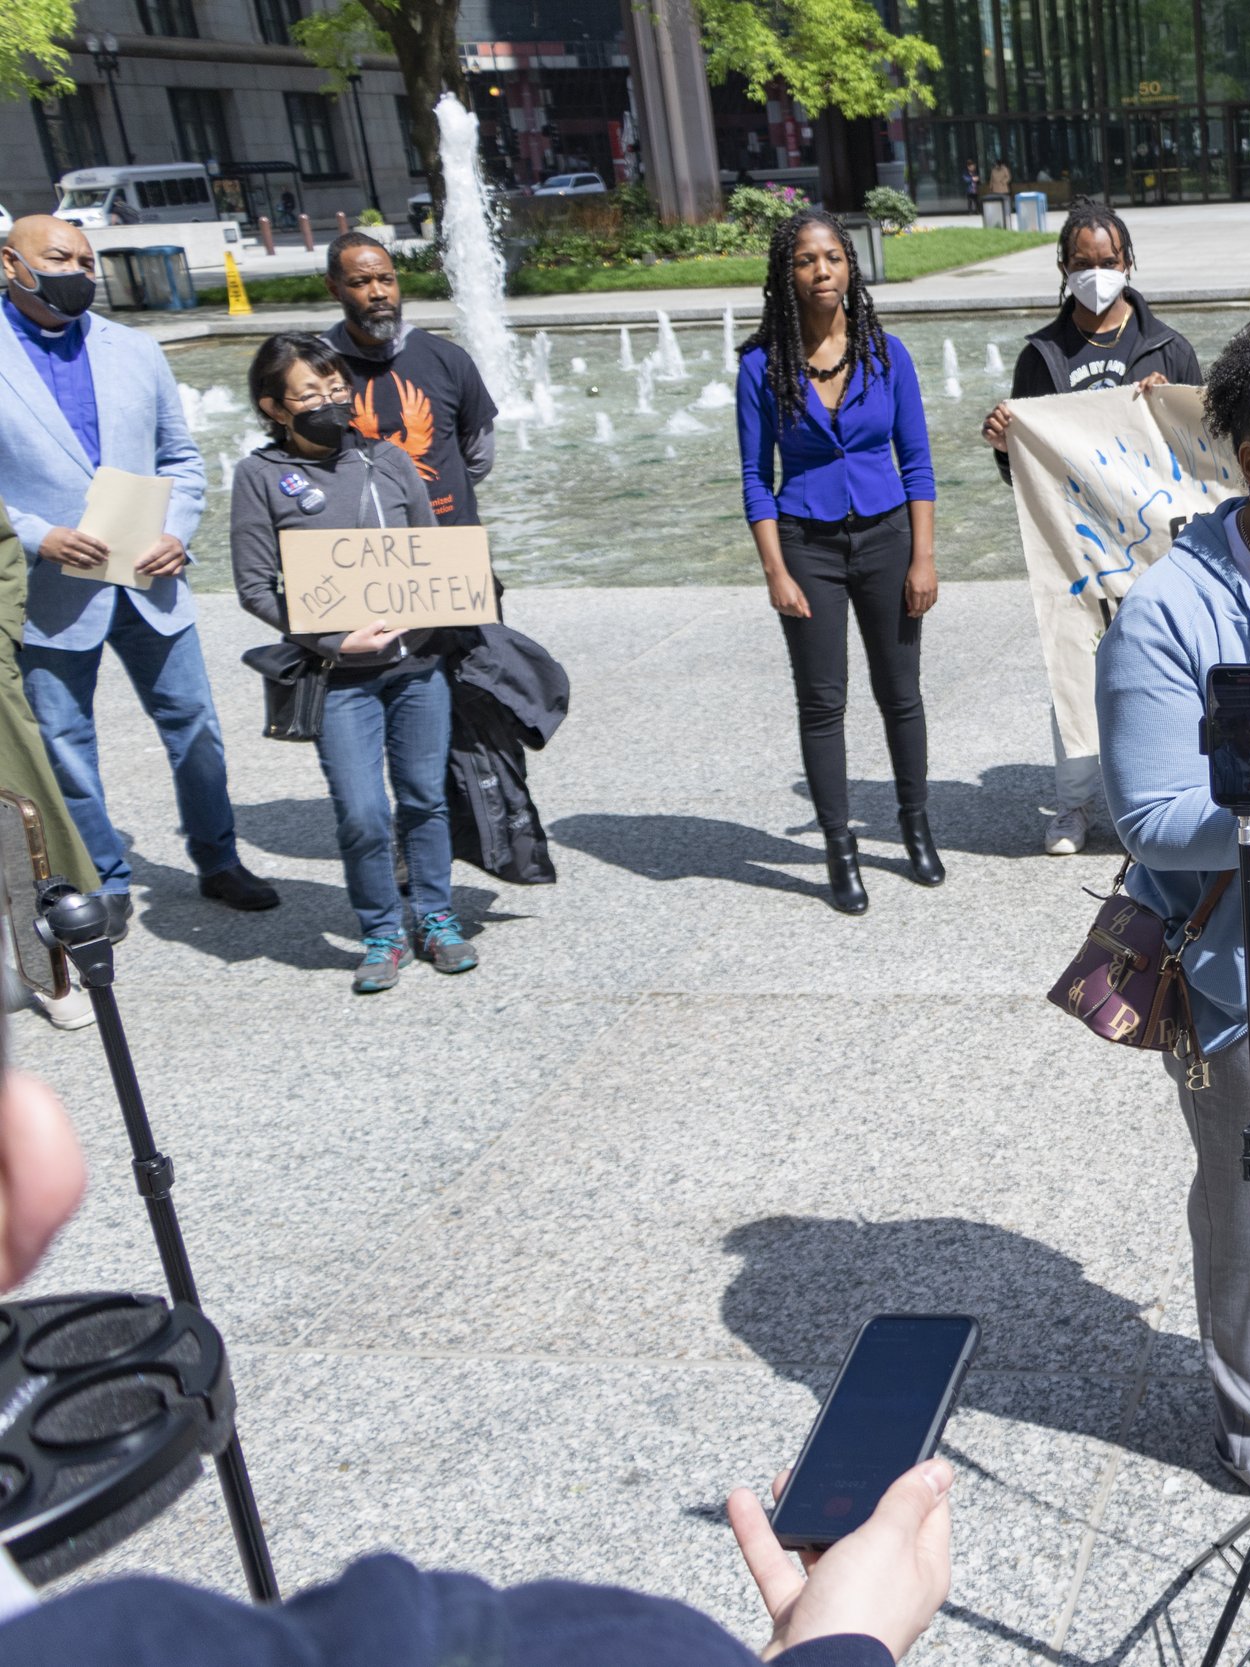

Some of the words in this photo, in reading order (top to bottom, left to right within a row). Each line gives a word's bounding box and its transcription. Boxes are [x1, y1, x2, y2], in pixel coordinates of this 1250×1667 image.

[1138, 80, 1161, 95] 50
[429, 493, 454, 507] nized
[331, 534, 431, 569] CARE
[363, 573, 488, 614] CURFEW
